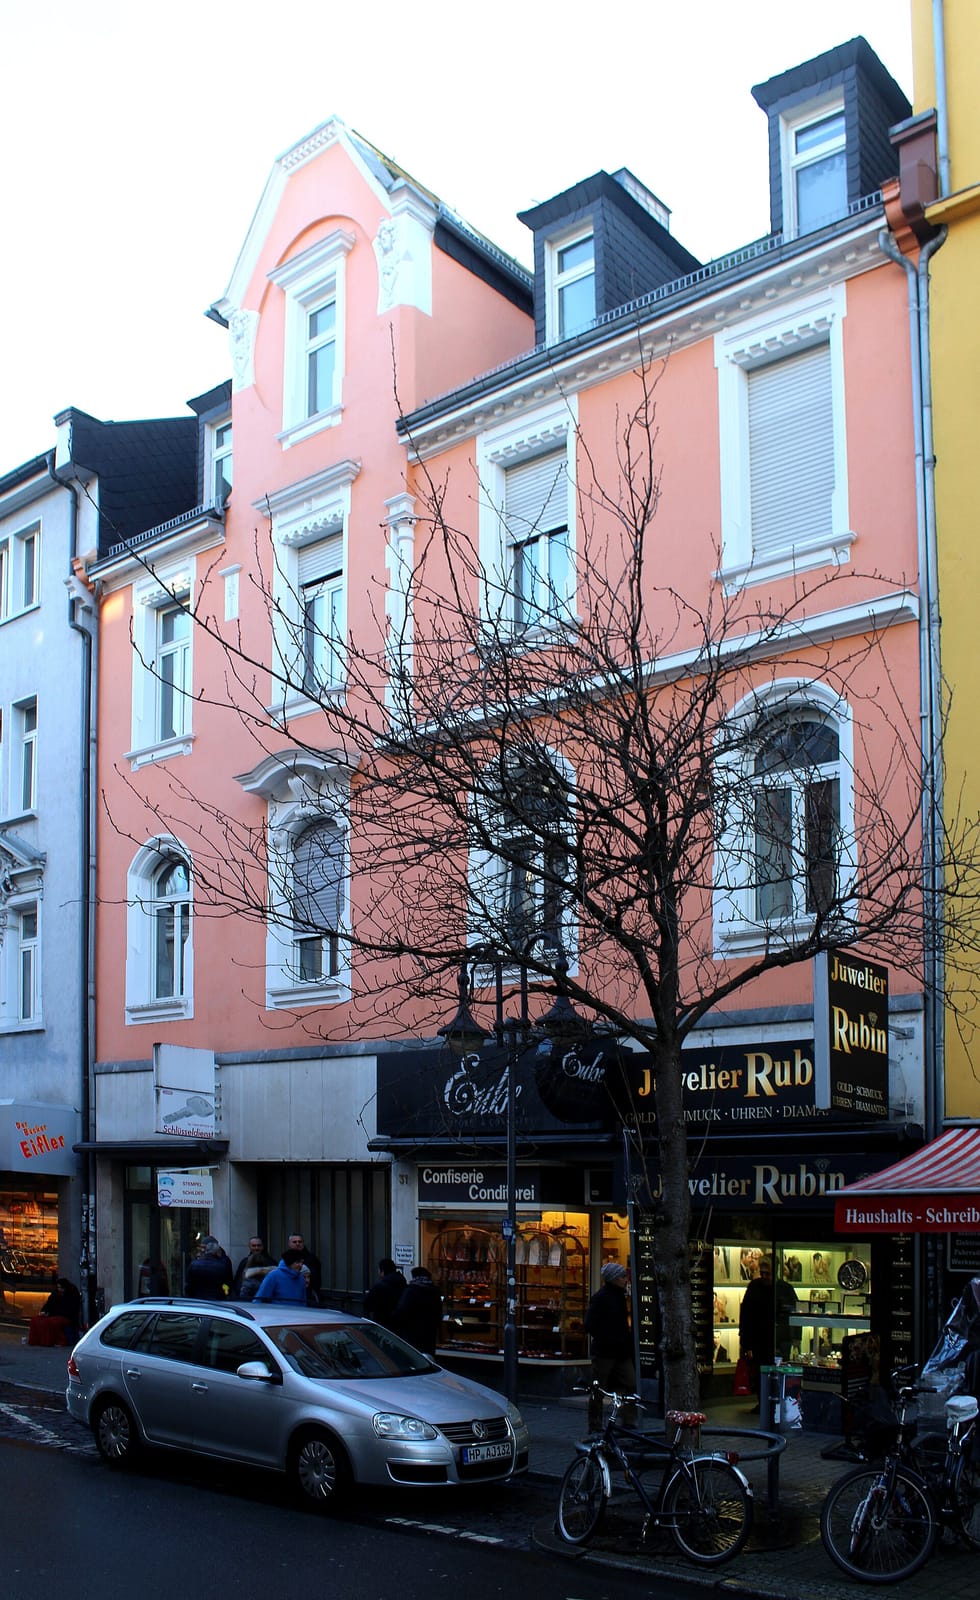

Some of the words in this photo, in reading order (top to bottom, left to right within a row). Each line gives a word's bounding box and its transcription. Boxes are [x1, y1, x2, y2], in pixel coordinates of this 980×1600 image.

[831, 956, 887, 996] Juwelier
[832, 1005, 888, 1055] Rubin
[638, 1064, 743, 1097] Jelier
[743, 1049, 813, 1098] Rub
[836, 1081, 853, 1094] GOLD
[625, 1111, 656, 1124] GOLD
[731, 1106, 773, 1120] UHREN
[20, 1134, 65, 1159] Eifler
[423, 1168, 484, 1185] Confiserie
[653, 1173, 751, 1200] Jwelier
[752, 1164, 846, 1205] Rubin
[846, 1208, 913, 1224] Haushalts
[469, 1449, 480, 1460] HP
